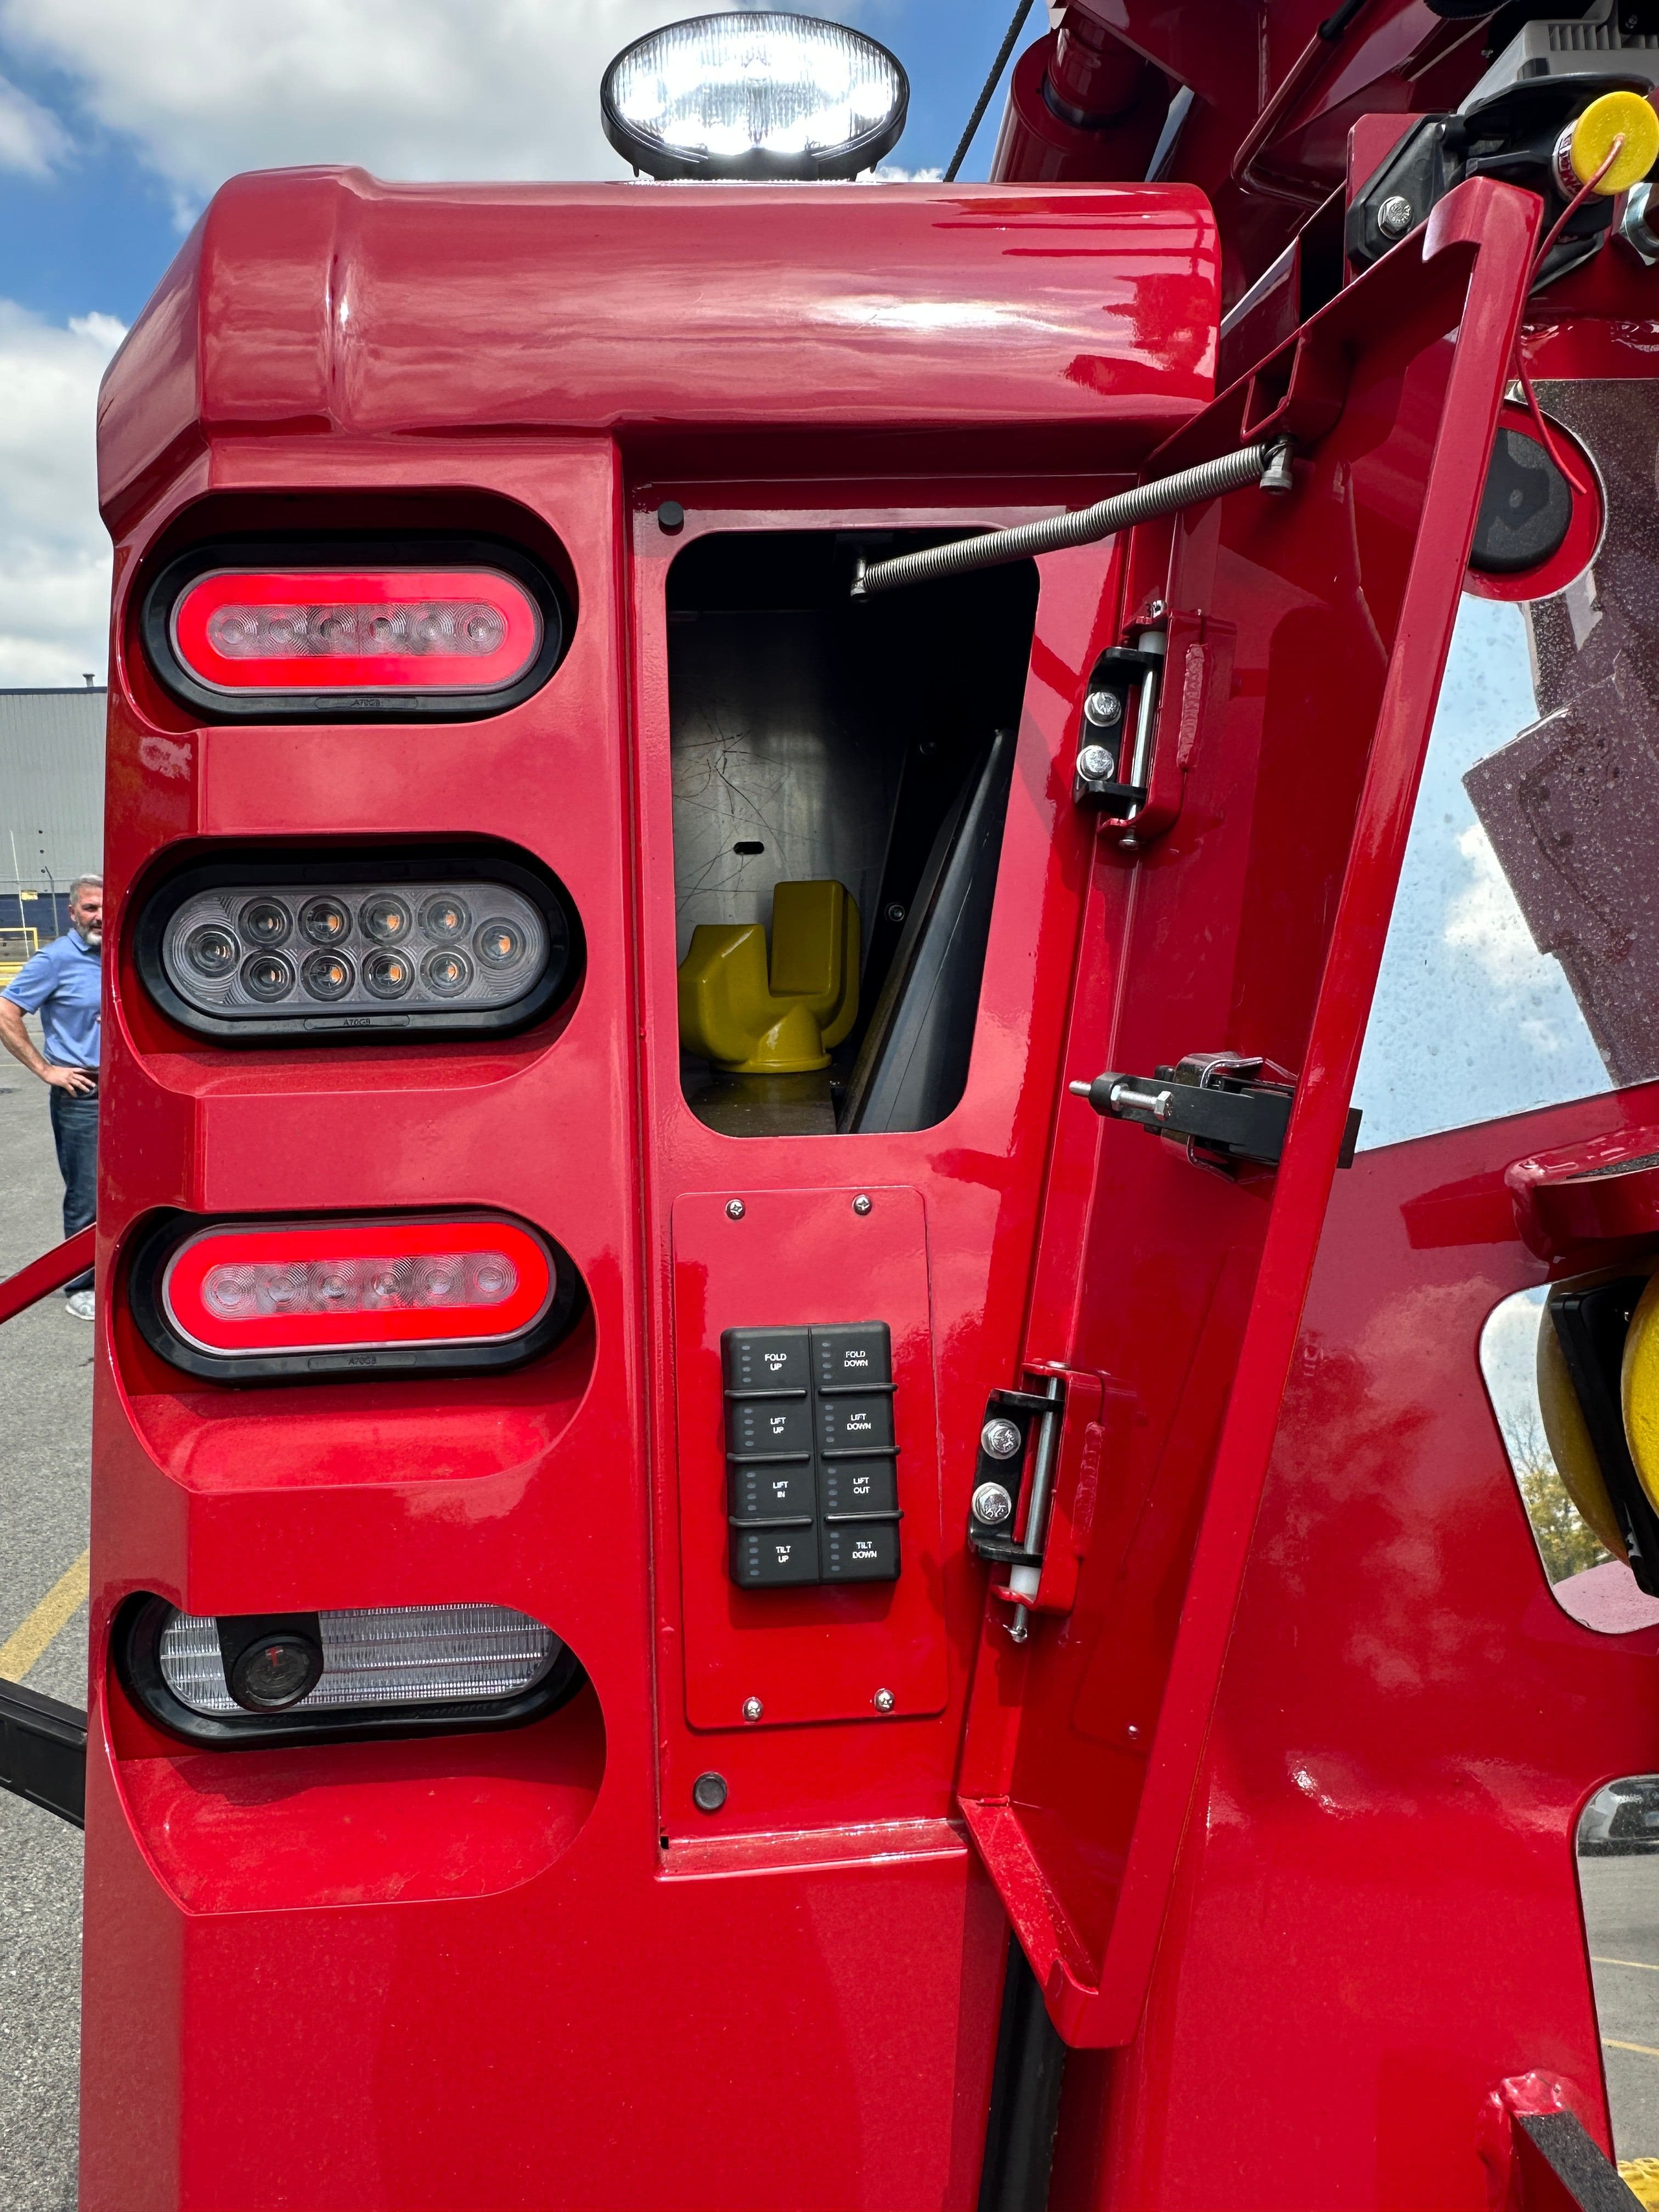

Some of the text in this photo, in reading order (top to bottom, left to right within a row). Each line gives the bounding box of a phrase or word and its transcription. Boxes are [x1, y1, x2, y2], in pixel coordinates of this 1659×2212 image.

[764, 1353, 787, 1362] FOLD
[845, 1350, 866, 1358] FOLD
[770, 1363, 782, 1371] UP
[844, 1359, 868, 1367] DOWN
[770, 1417, 787, 1425] LIFT
[850, 1413, 867, 1421] LIFT
[772, 1426, 785, 1434] UP
[847, 1422, 872, 1431] DOWN
[772, 1481, 789, 1489] LIFT
[853, 1477, 870, 1485] LIFT
[853, 1486, 871, 1494] OUT
[856, 1541, 873, 1549] TILT
[775, 1545, 792, 1554] TILT
[852, 1550, 877, 1559] DOWN
[778, 1555, 789, 1564] UP
